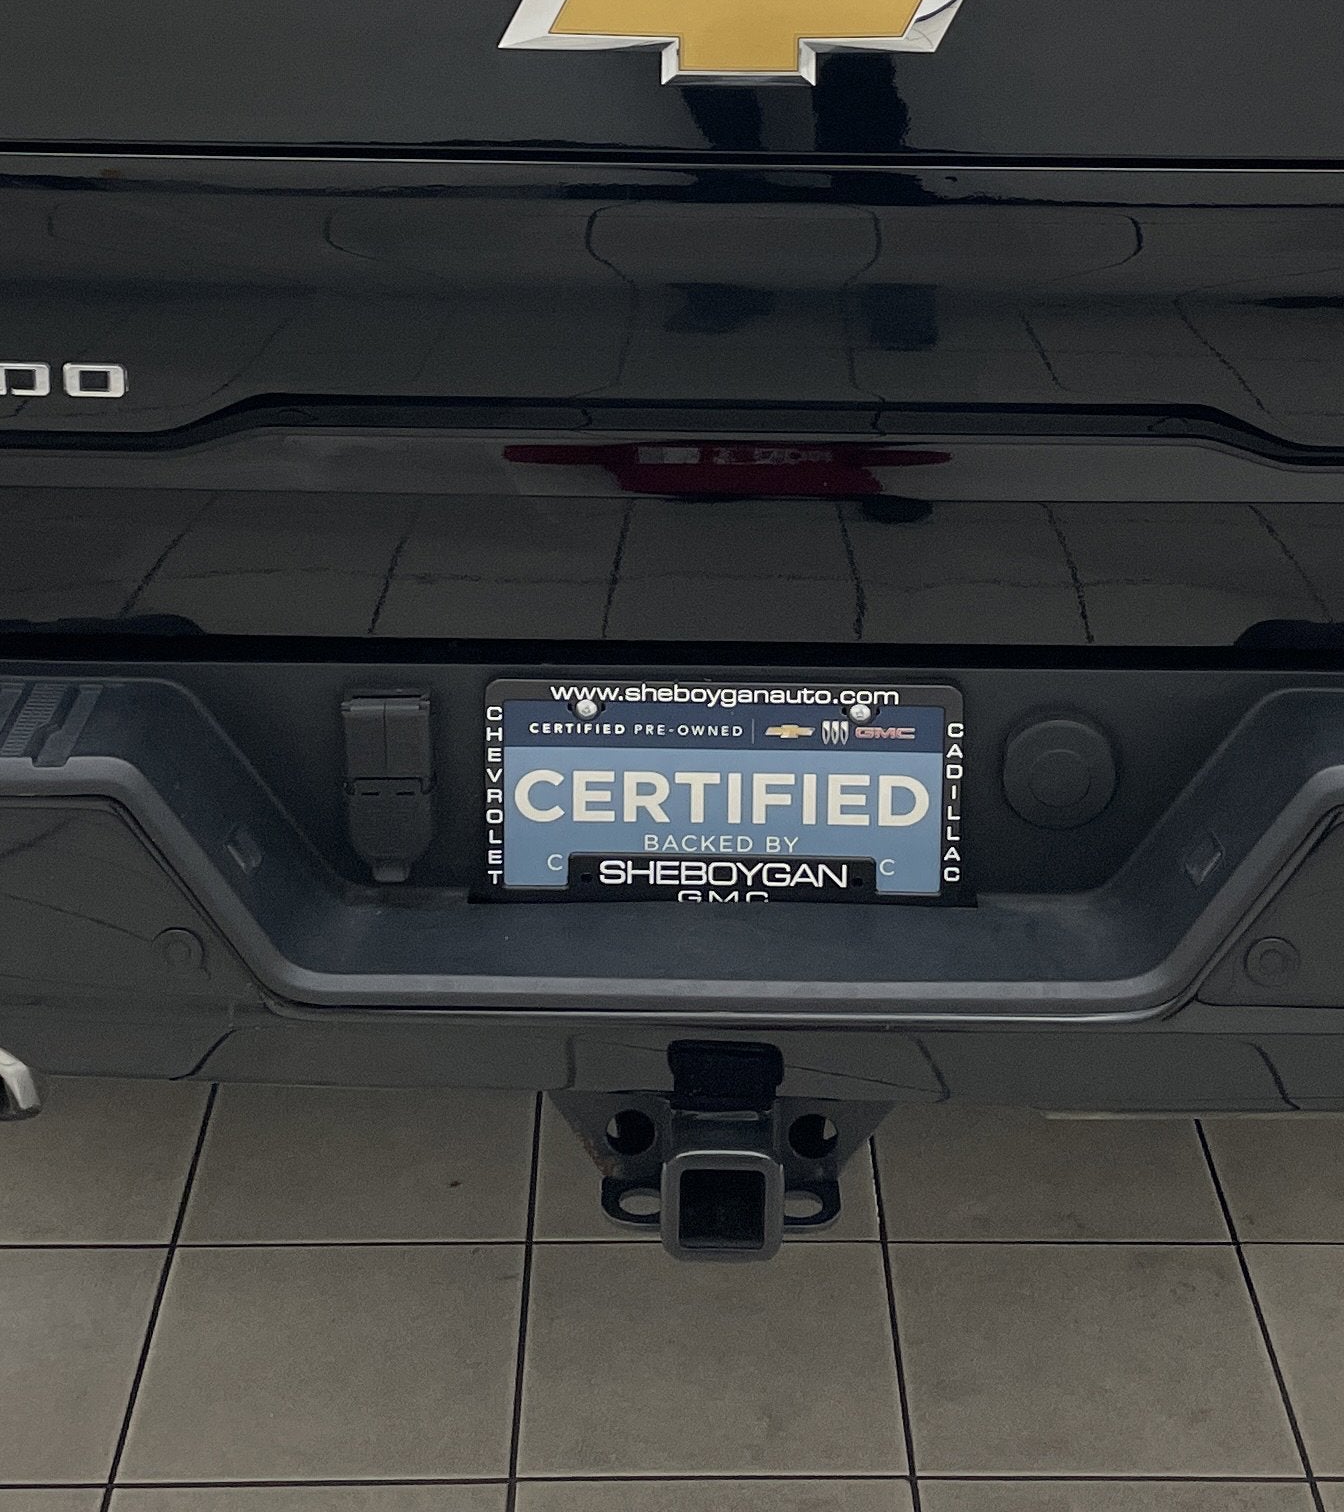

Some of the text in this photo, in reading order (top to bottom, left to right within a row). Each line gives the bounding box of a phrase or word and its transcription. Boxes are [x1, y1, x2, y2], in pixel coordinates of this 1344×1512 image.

[550, 683, 900, 708] www.sheboyganauto.com
[529, 722, 743, 737] CERTIFIED PRE-OWNED
[855, 726, 916, 740] GMC
[486, 706, 504, 885] CHEVROLET
[514, 769, 930, 827] CERTIFIED
[944, 722, 964, 883] CADILLAC
[644, 834, 799, 854] BACKED BY
[599, 860, 848, 888] SHEBOYGAN
